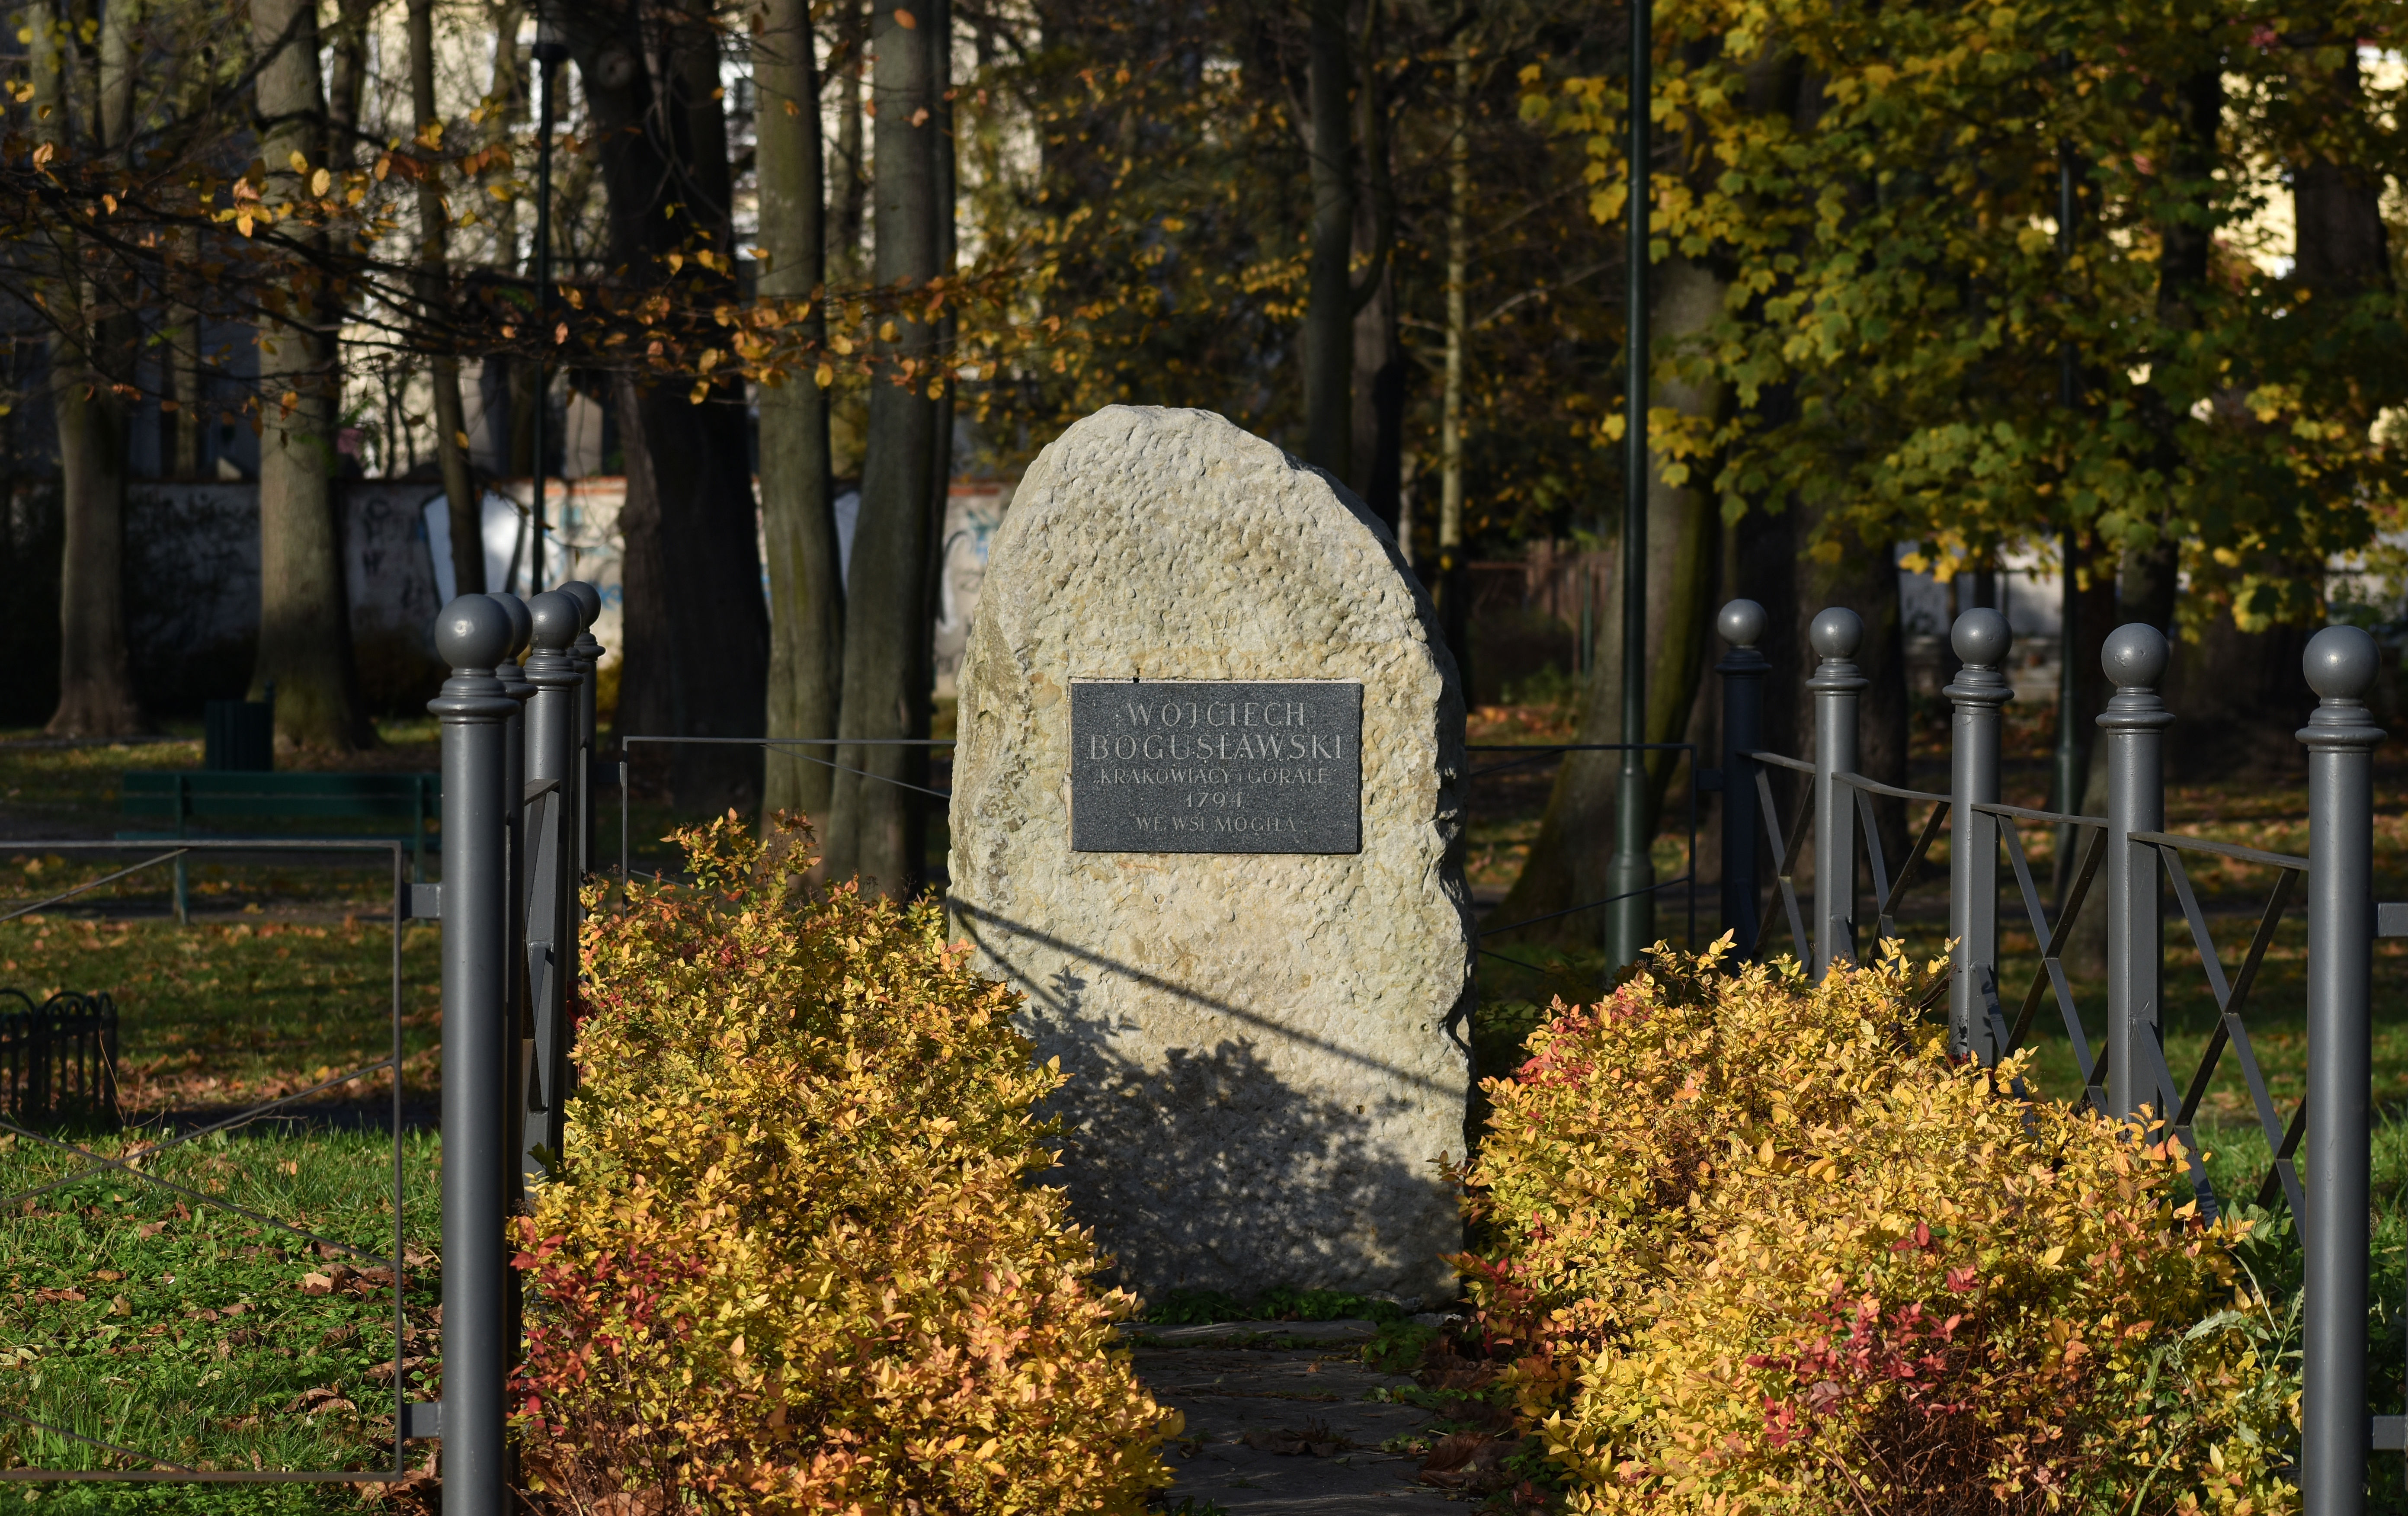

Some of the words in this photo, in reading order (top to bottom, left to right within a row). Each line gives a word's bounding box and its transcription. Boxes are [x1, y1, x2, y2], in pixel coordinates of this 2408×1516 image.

[1127, 702, 1304, 729] WOJCIECH
[1090, 734, 1341, 760] BOGUSŁAWSKI
[1185, 791, 1242, 810] 1794
[1172, 816, 1204, 831] WSI
[1214, 816, 1297, 832] MOGIŁA
